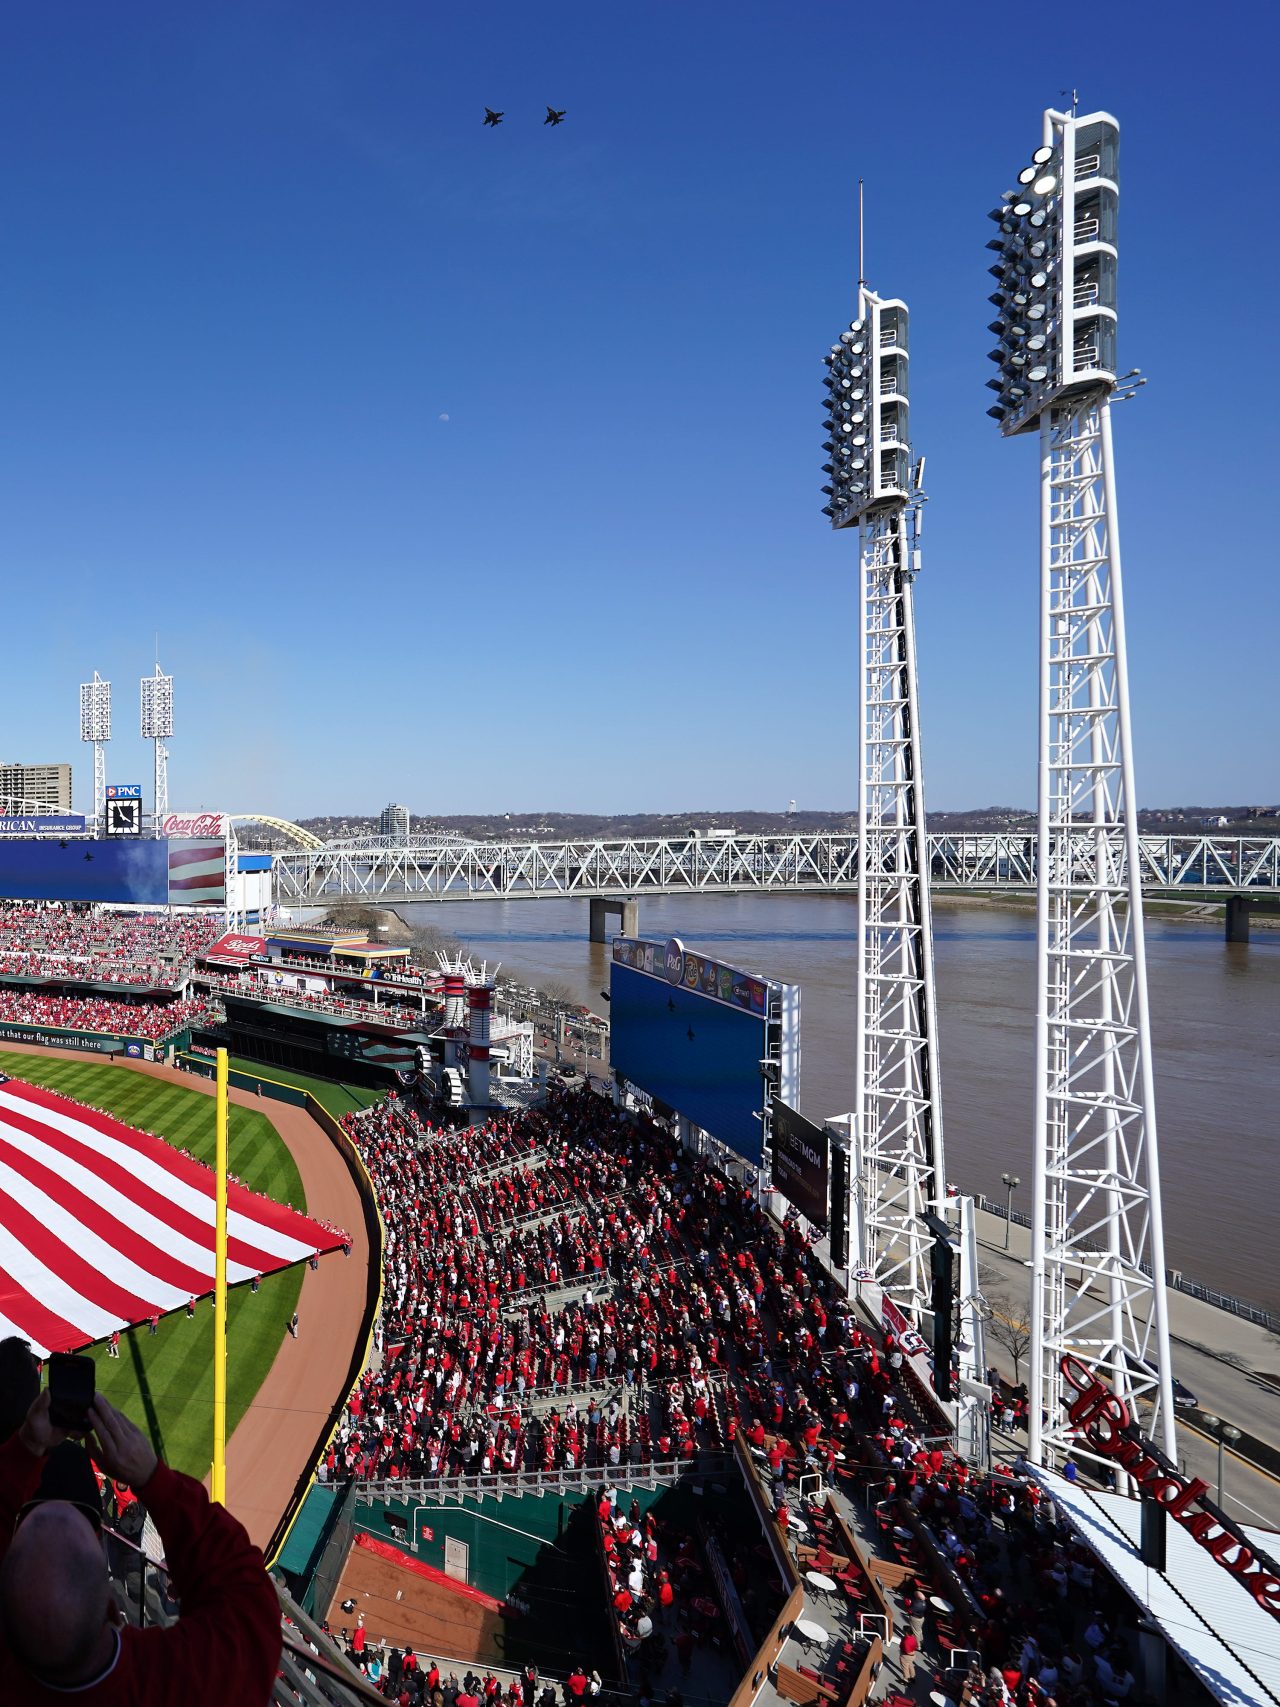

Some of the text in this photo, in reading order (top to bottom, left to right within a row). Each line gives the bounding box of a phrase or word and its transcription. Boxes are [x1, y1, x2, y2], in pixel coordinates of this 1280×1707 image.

[117, 786, 140, 796] PNC
[163, 814, 224, 836] Coca-Cola
[666, 953, 681, 971] P&G
[390, 973, 423, 985] TriHealth
[7, 1029, 21, 1039] that
[36, 1032, 49, 1045] flag
[65, 1037, 80, 1046] still
[81, 1039, 101, 1049] there
[626, 1080, 653, 1107] GRAVITY
[790, 1133, 821, 1169] BETMGM
